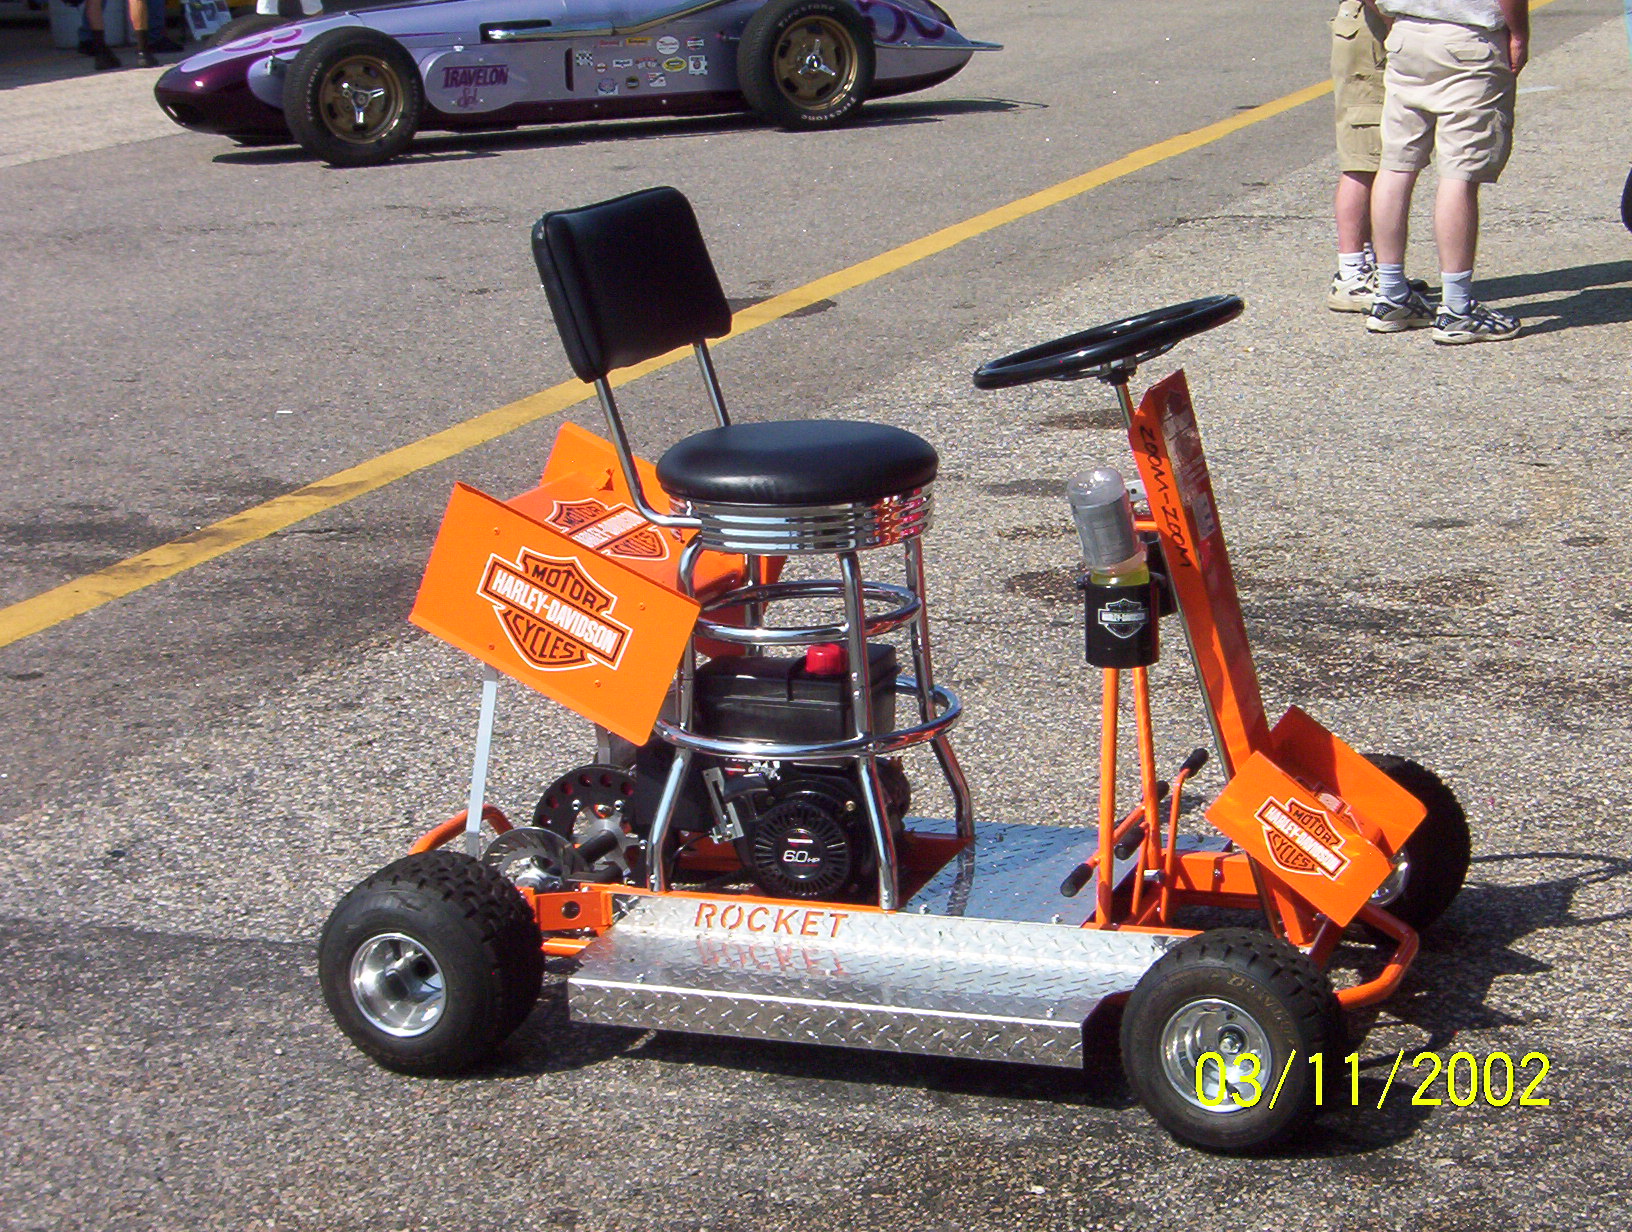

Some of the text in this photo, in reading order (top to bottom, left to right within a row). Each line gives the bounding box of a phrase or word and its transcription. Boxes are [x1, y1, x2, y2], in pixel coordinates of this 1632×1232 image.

[441, 64, 510, 90] TRAVELON
[800, 96, 859, 122] Firestone
[1139, 425, 1192, 568] ZOOM-ZOOM
[532, 565, 599, 609] MOTOR
[491, 569, 622, 655] HARLEY-DAVIDSON
[512, 613, 577, 660] CYCLES
[1264, 806, 1342, 872] HARLEY-DAVIDSON
[1292, 809, 1333, 844] MOTOR
[1271, 834, 1312, 868] CYCLES
[694, 903, 849, 938] ROCKET
